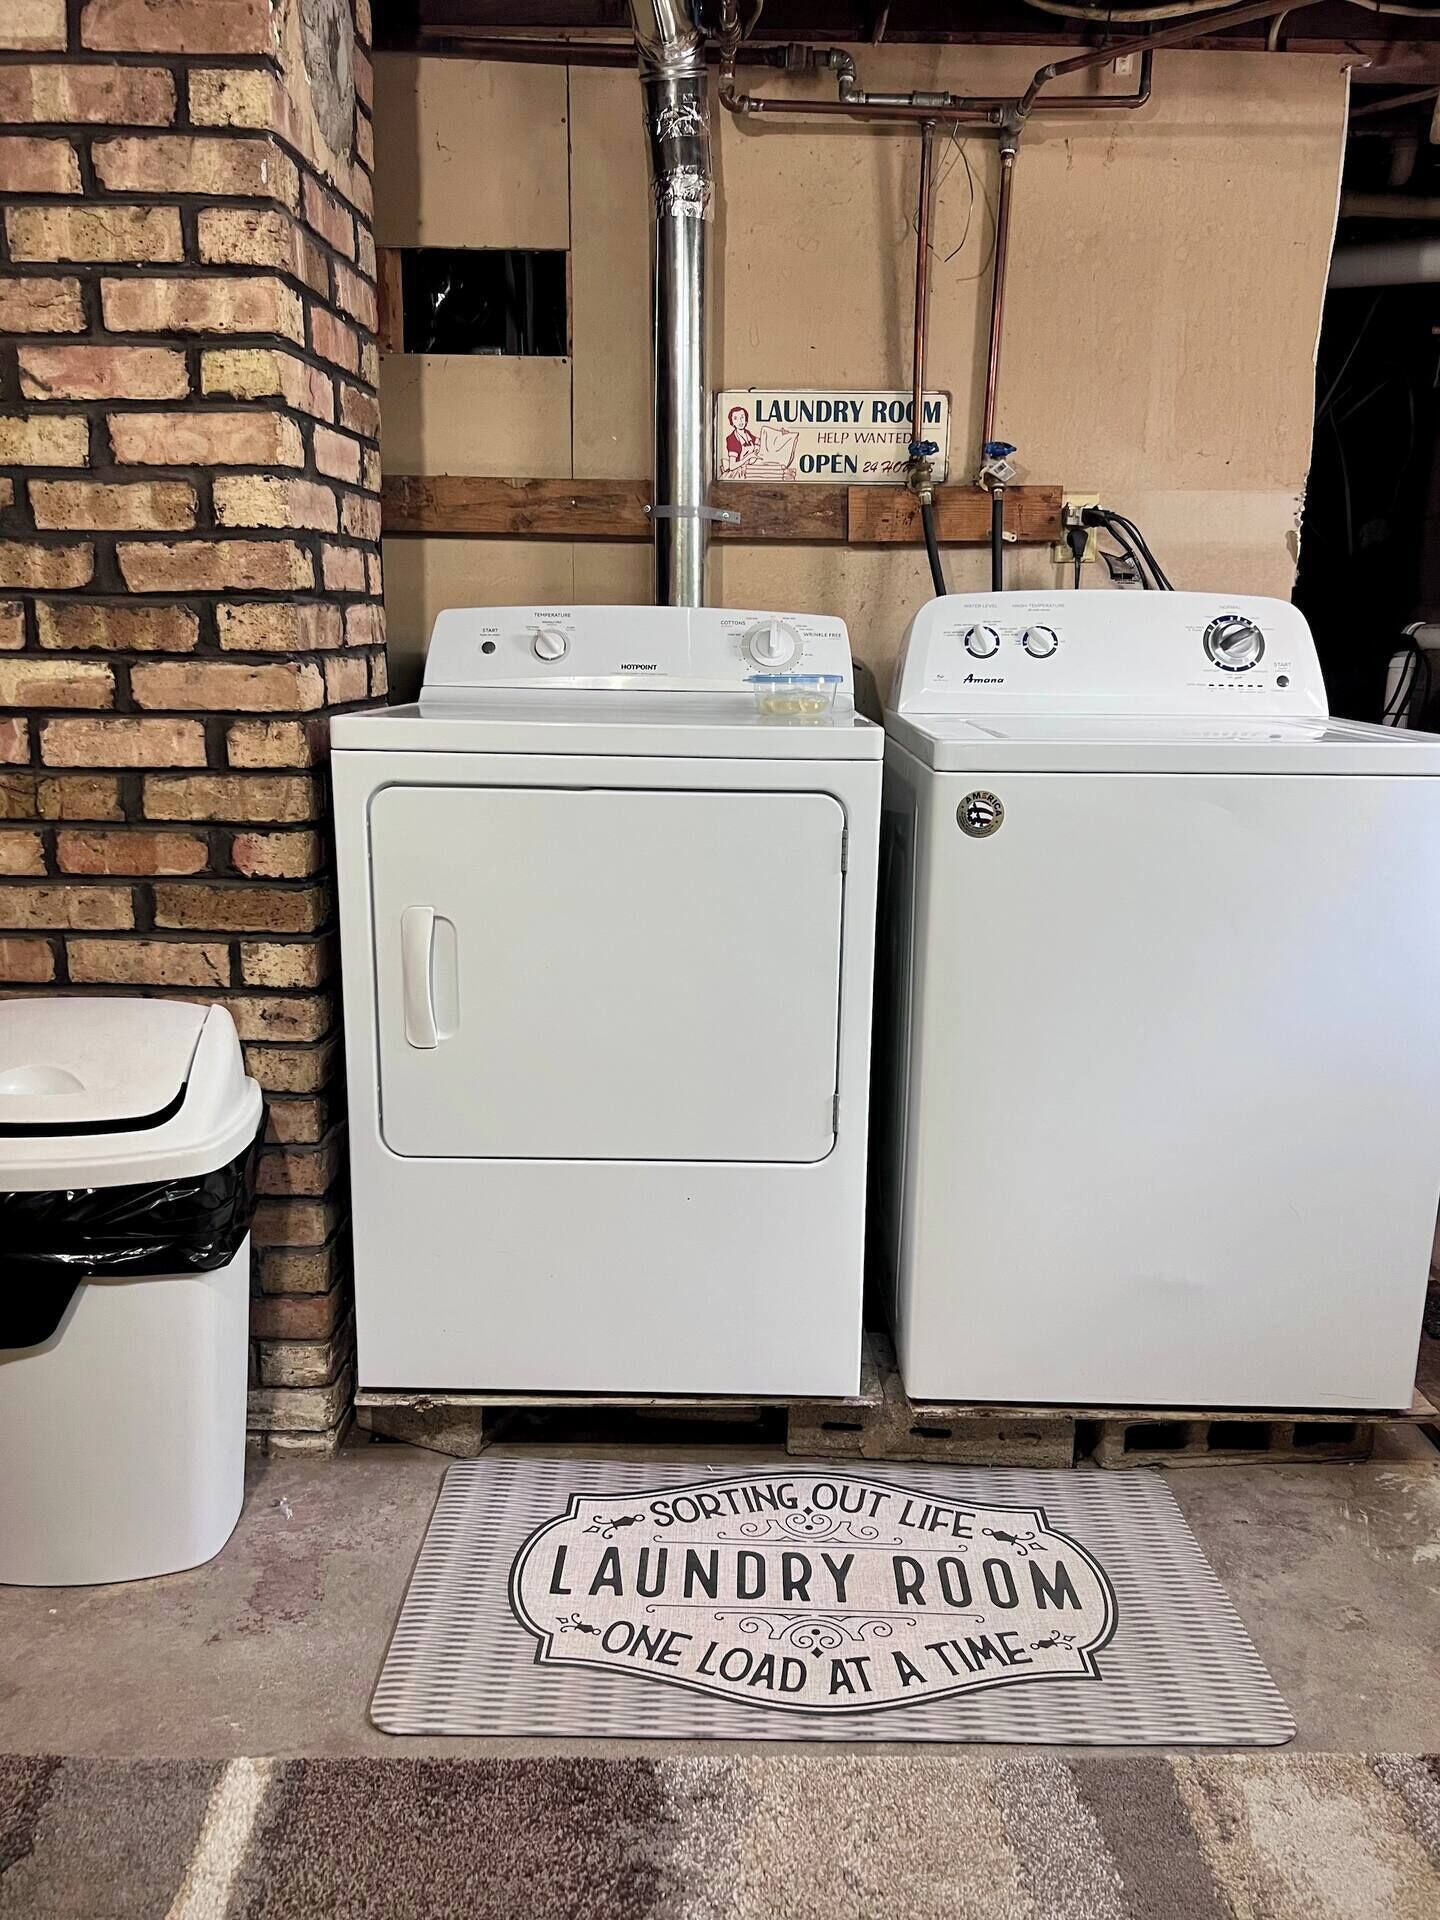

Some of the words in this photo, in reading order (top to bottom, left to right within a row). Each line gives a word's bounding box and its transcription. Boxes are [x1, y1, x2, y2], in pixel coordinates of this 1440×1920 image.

[755, 400, 864, 422] LAUNDRY
[872, 401, 941, 423] ROOM
[817, 432, 849, 444] HELP
[855, 432, 912, 444] WANTED
[799, 454, 858, 473] OPEN
[862, 461, 879, 473] 24
[620, 663, 658, 671] HOTPOINT
[963, 673, 1005, 684] Amana
[965, 791, 1003, 817] AMERICA
[650, 1482, 799, 1528] SORTING
[812, 1484, 889, 1517] OUT
[898, 1499, 977, 1540] LIFE
[548, 1544, 855, 1604] LAUNDRY
[893, 1554, 1084, 1611] ROOM
[600, 1620, 694, 1665] ONE
[695, 1641, 808, 1693] LOAD
[828, 1656, 871, 1696] AT
[891, 1650, 928, 1688] A
[925, 1630, 1034, 1677] TIME
